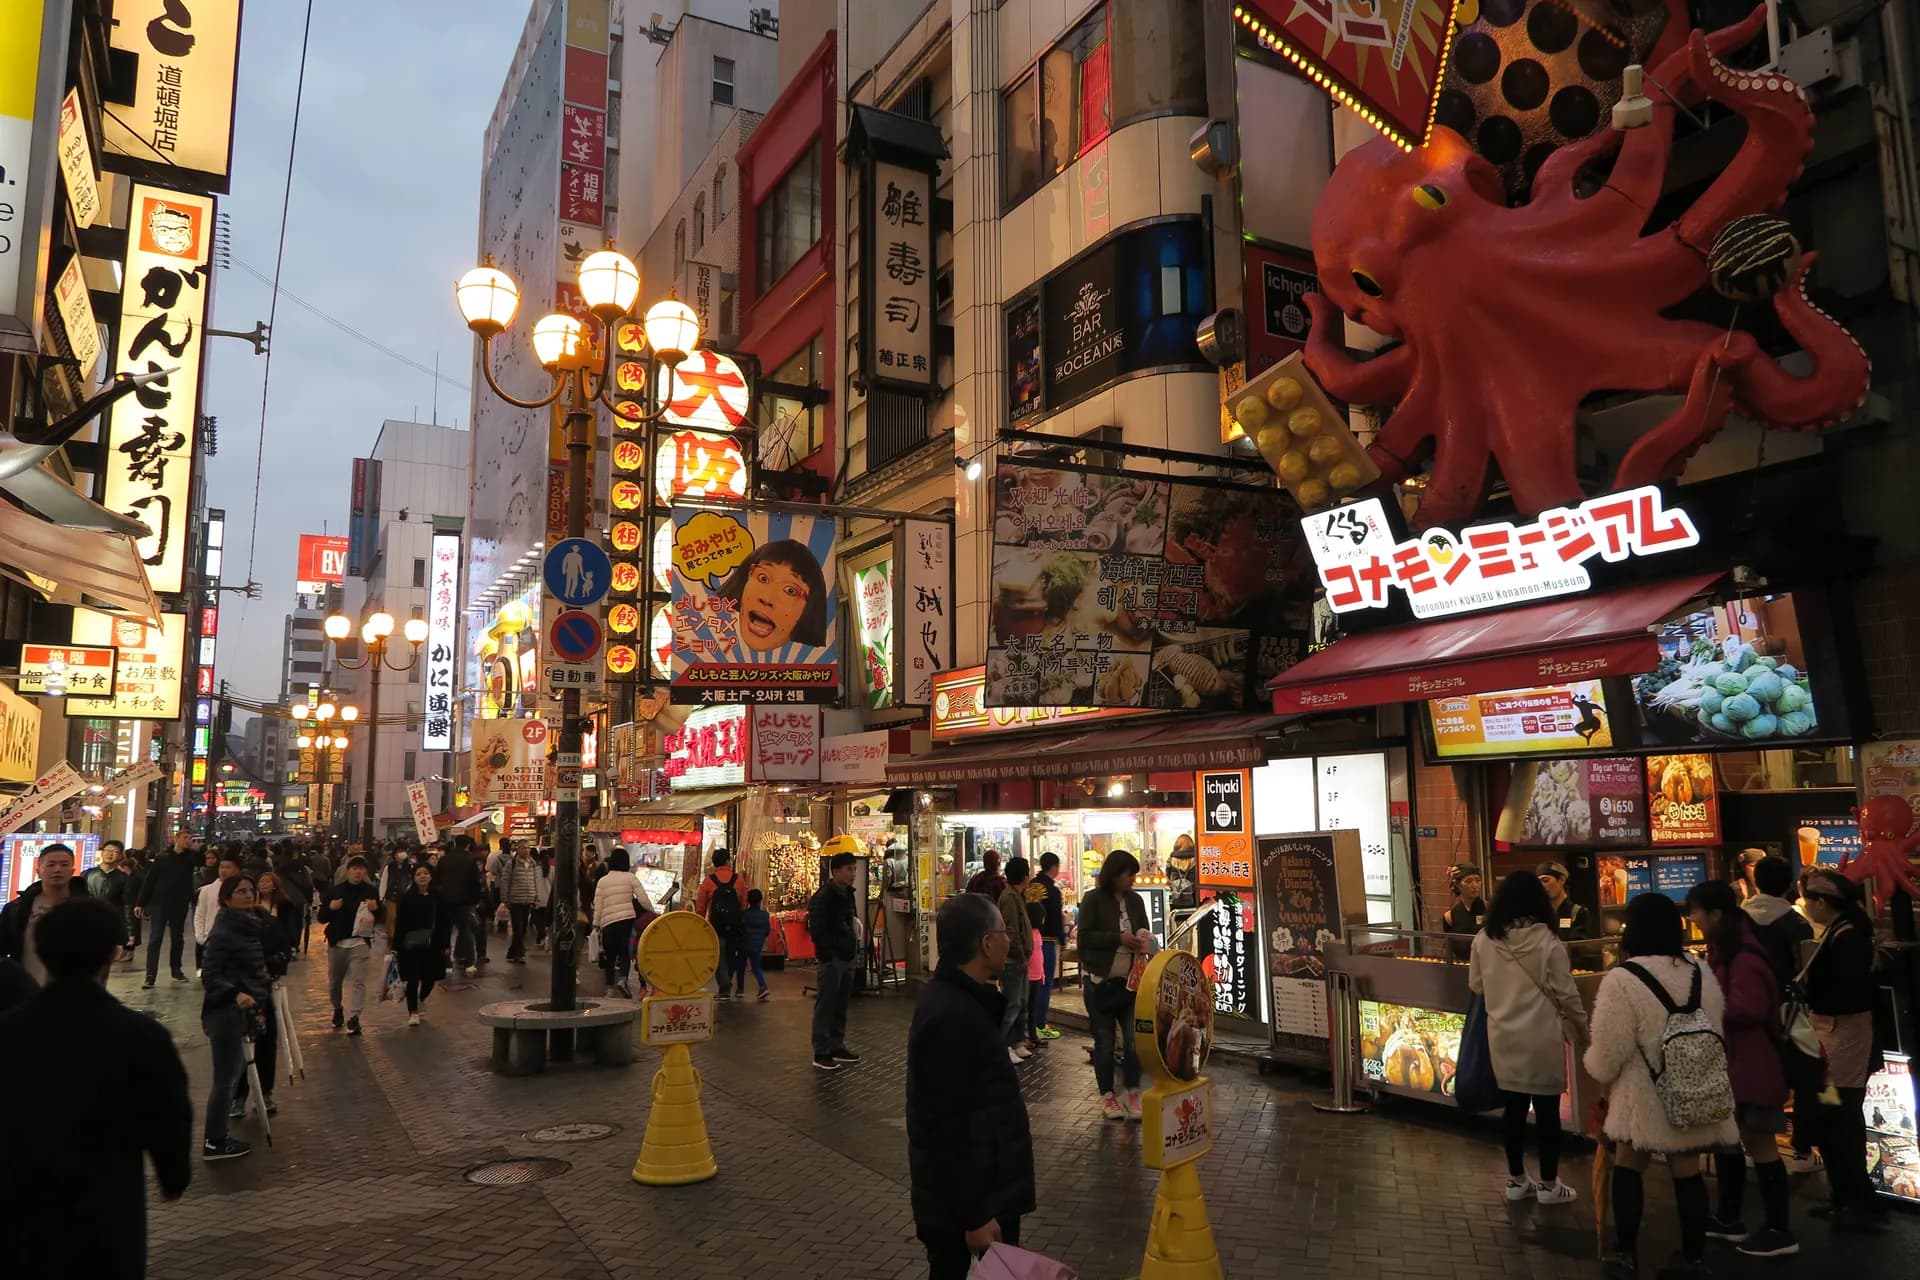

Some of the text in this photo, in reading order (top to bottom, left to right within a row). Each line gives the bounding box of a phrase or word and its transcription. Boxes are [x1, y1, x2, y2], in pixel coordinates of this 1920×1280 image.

[152, 63, 183, 152] 道頓堀店
[564, 106, 577, 117] 8F
[560, 226, 575, 237] 6F
[1073, 313, 1101, 342] BAR
[878, 347, 928, 373] 菊正宗
[1063, 338, 1112, 376] OCEAN
[1009, 486, 1089, 508] 欢迎光临
[1013, 512, 1088, 533] 어서오세요
[1326, 508, 1369, 546] くくる
[680, 524, 737, 560] おみやげ
[1324, 495, 1690, 606] コナモンミュージアム
[1099, 556, 1205, 588] 海鮮居酒屋
[434, 569, 453, 631] 本場の味
[676, 595, 738, 612] よしもと
[1097, 584, 1201, 616] 해선호프집
[1415, 575, 1586, 614] Dotonbori KUKURU Konamon-Museum
[676, 615, 738, 634] エンタメ
[675, 637, 738, 654] ショップ
[551, 668, 597, 683] 自動車
[1537, 658, 1608, 676] コナモンミュージアム
[69, 671, 107, 689] 和食
[1408, 678, 1466, 692] コナモンミュージアム
[758, 712, 813, 729] よしもと
[525, 727, 544, 738] 2F
[759, 730, 815, 747] エンタメ
[530, 758, 544, 767] NY
[758, 748, 814, 766] ショップ
[496, 774, 544, 782] MONSTER
[514, 766, 545, 774] STYLE
[1326, 766, 1338, 776] 4F
[1206, 779, 1240, 801] ichiaki
[1329, 818, 1341, 828] 2F
[1200, 860, 1250, 878] お好み焼き
[1163, 982, 1178, 999] NO.1
